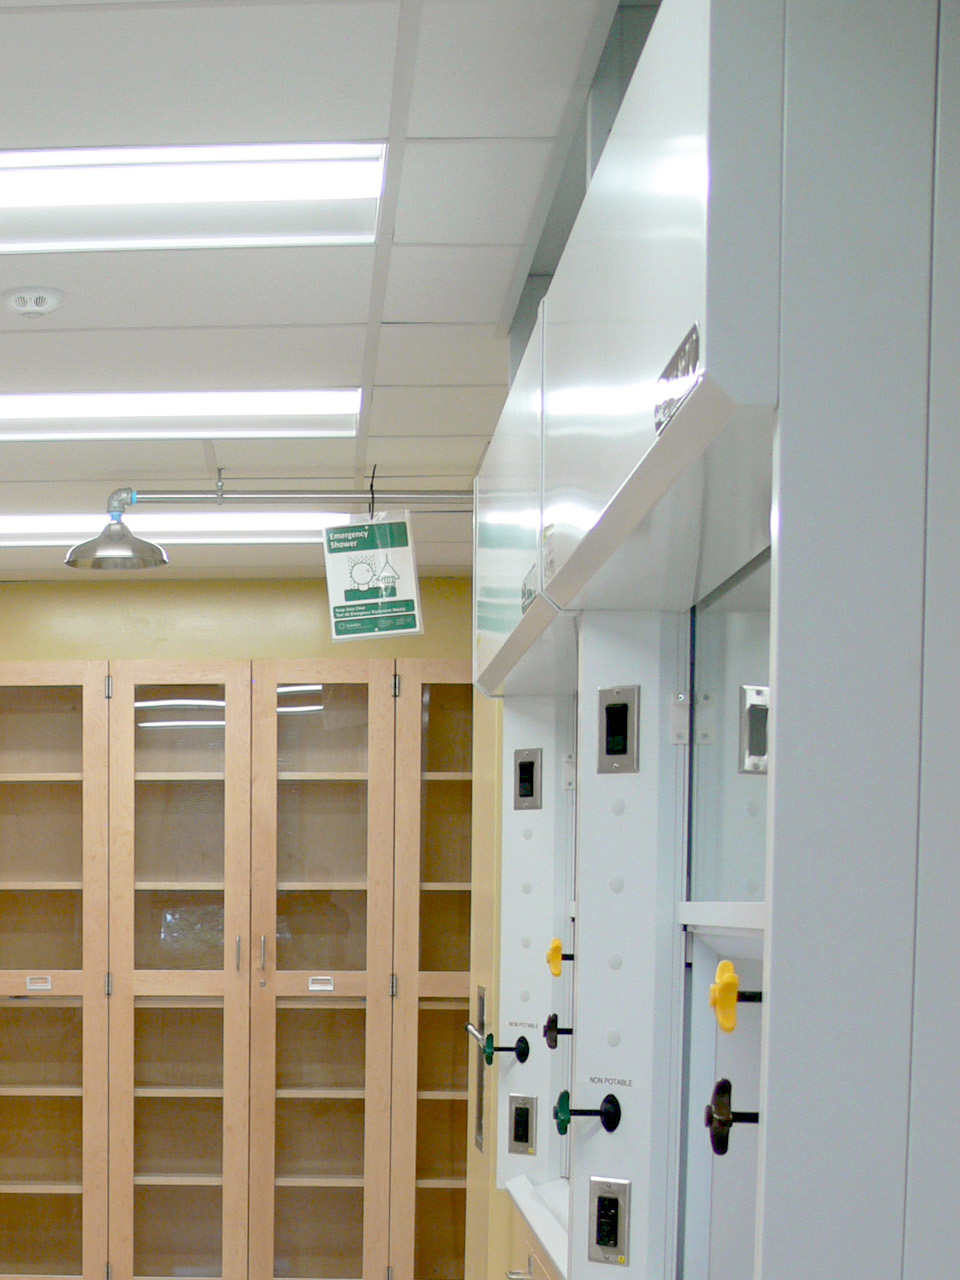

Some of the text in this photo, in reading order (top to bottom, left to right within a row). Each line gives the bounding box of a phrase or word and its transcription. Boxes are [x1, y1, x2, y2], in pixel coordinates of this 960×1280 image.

[329, 531, 369, 540] Emergency
[330, 541, 358, 549] Shower
[589, 1076, 633, 1087] NON POTABLE
